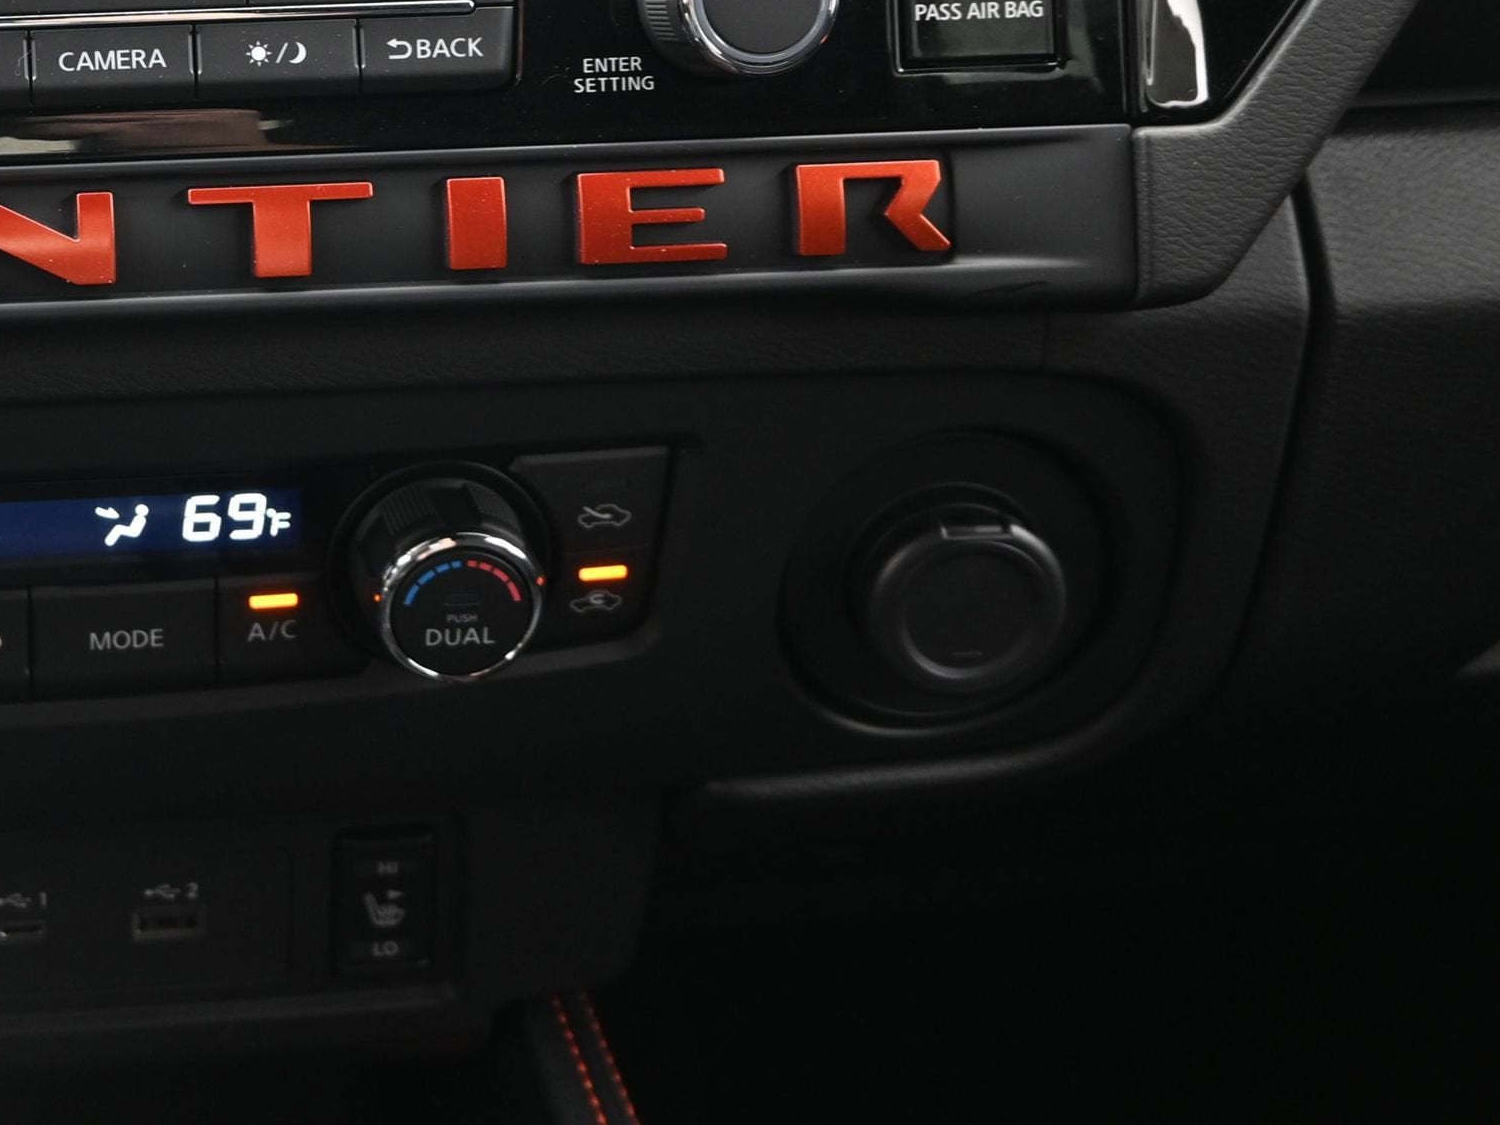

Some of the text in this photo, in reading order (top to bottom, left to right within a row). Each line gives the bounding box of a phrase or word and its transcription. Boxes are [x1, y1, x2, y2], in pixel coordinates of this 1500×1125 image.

[914, 0, 1043, 21] PASS AIR BAG
[416, 37, 484, 60] BACK
[58, 48, 167, 73] CAMERA
[582, 56, 643, 74] ENTER
[573, 75, 655, 94] SETTING
[446, 612, 479, 624] PUSH
[88, 627, 165, 651] MODE
[247, 619, 298, 643] A/C
[425, 626, 496, 648] DUAL
[377, 860, 400, 875] HI
[372, 940, 400, 958] LO
